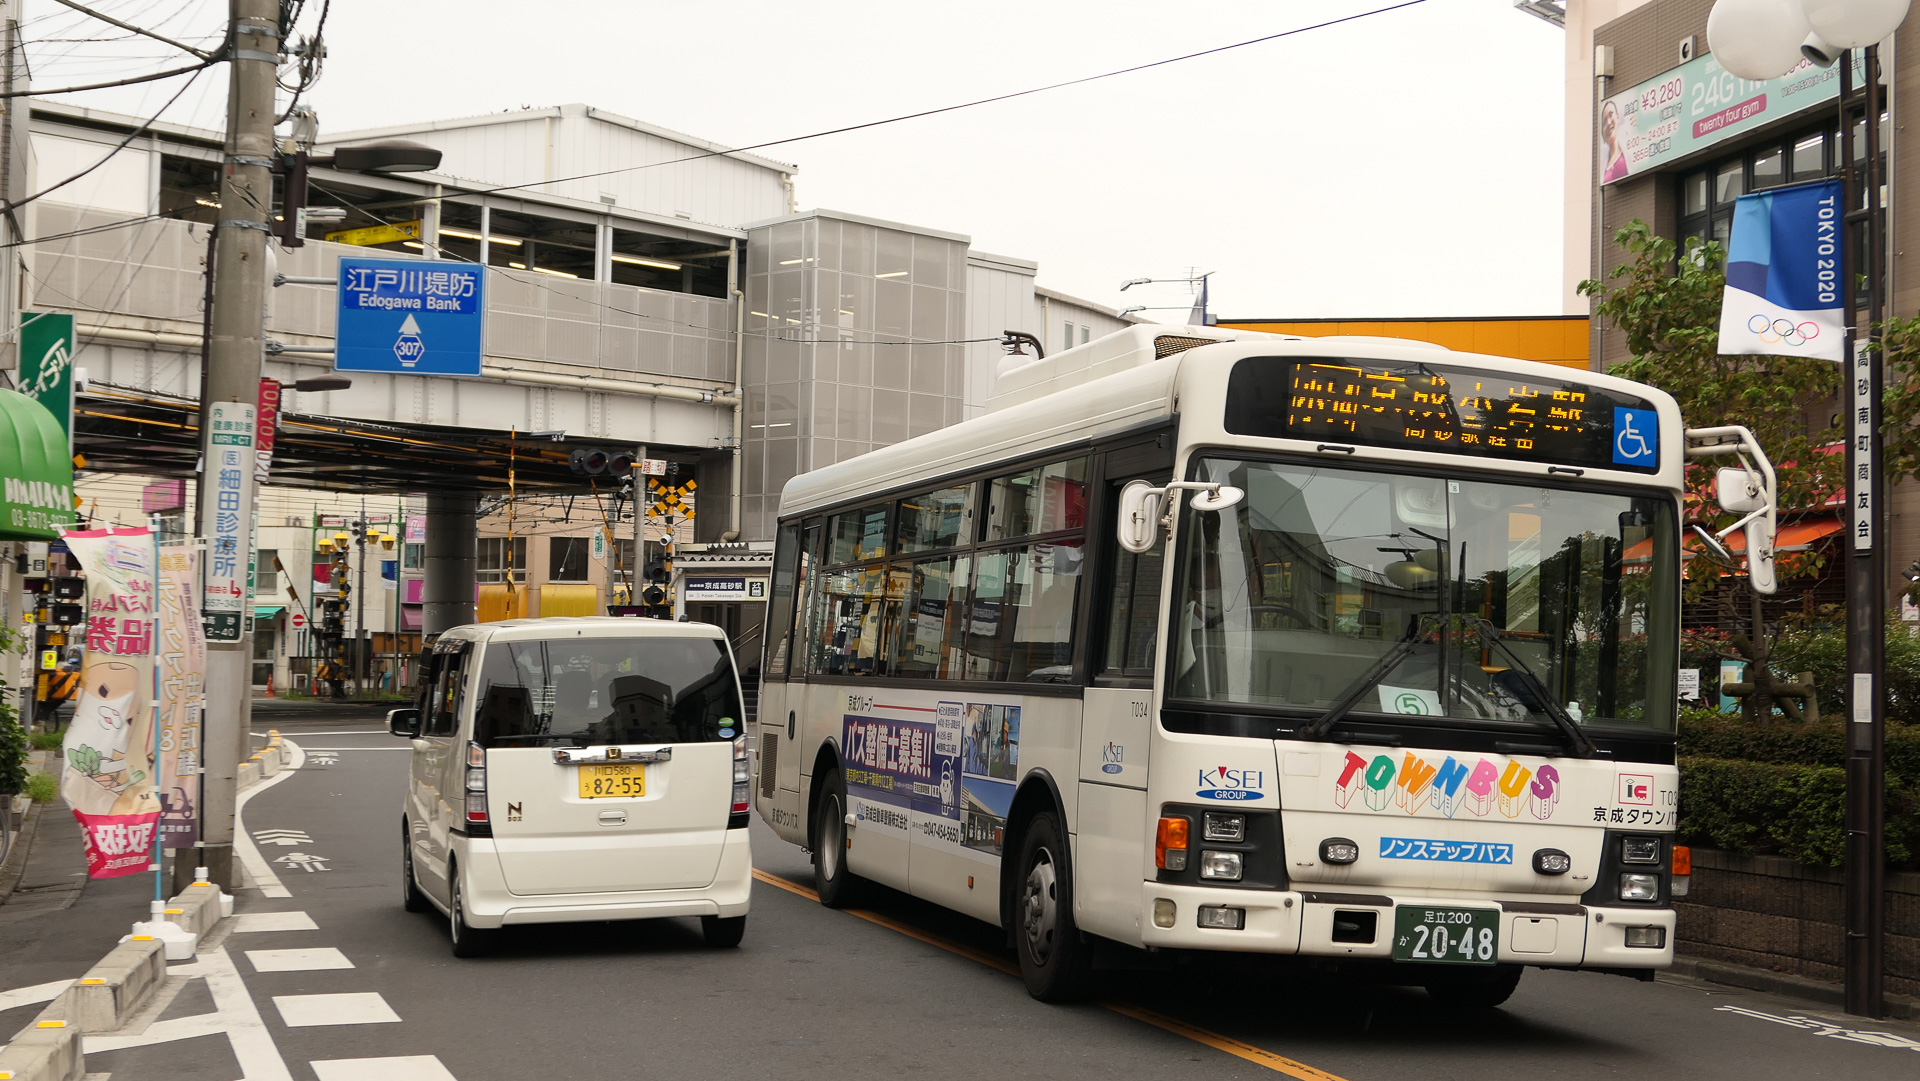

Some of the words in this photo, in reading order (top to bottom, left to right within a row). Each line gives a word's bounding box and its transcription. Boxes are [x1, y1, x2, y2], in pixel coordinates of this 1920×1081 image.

[1642, 78, 1682, 111] ¥3,280
[1699, 114, 1725, 133] twenty
[1725, 108, 1741, 124] four
[1742, 101, 1760, 118] gym
[1817, 195, 1835, 255] TOKYO
[346, 268, 476, 298] 江戸川堤防
[1817, 259, 1836, 303] 2020
[358, 293, 421, 310] Edogawa
[426, 297, 461, 310] Bank
[398, 342, 420, 356] 307
[260, 379, 280, 437] TOKYO
[253, 441, 273, 484] 2020
[206, 627, 235, 637] 2-40
[1131, 701, 1148, 717] T034
[594, 777, 642, 795] 82-55
[1214, 790, 1247, 800] GROUP
[1335, 750, 1560, 821] TOWNBUS
[1381, 838, 1514, 863] ノンステップバス
[1399, 935, 1410, 948] か
[1412, 924, 1494, 961] 20-48
